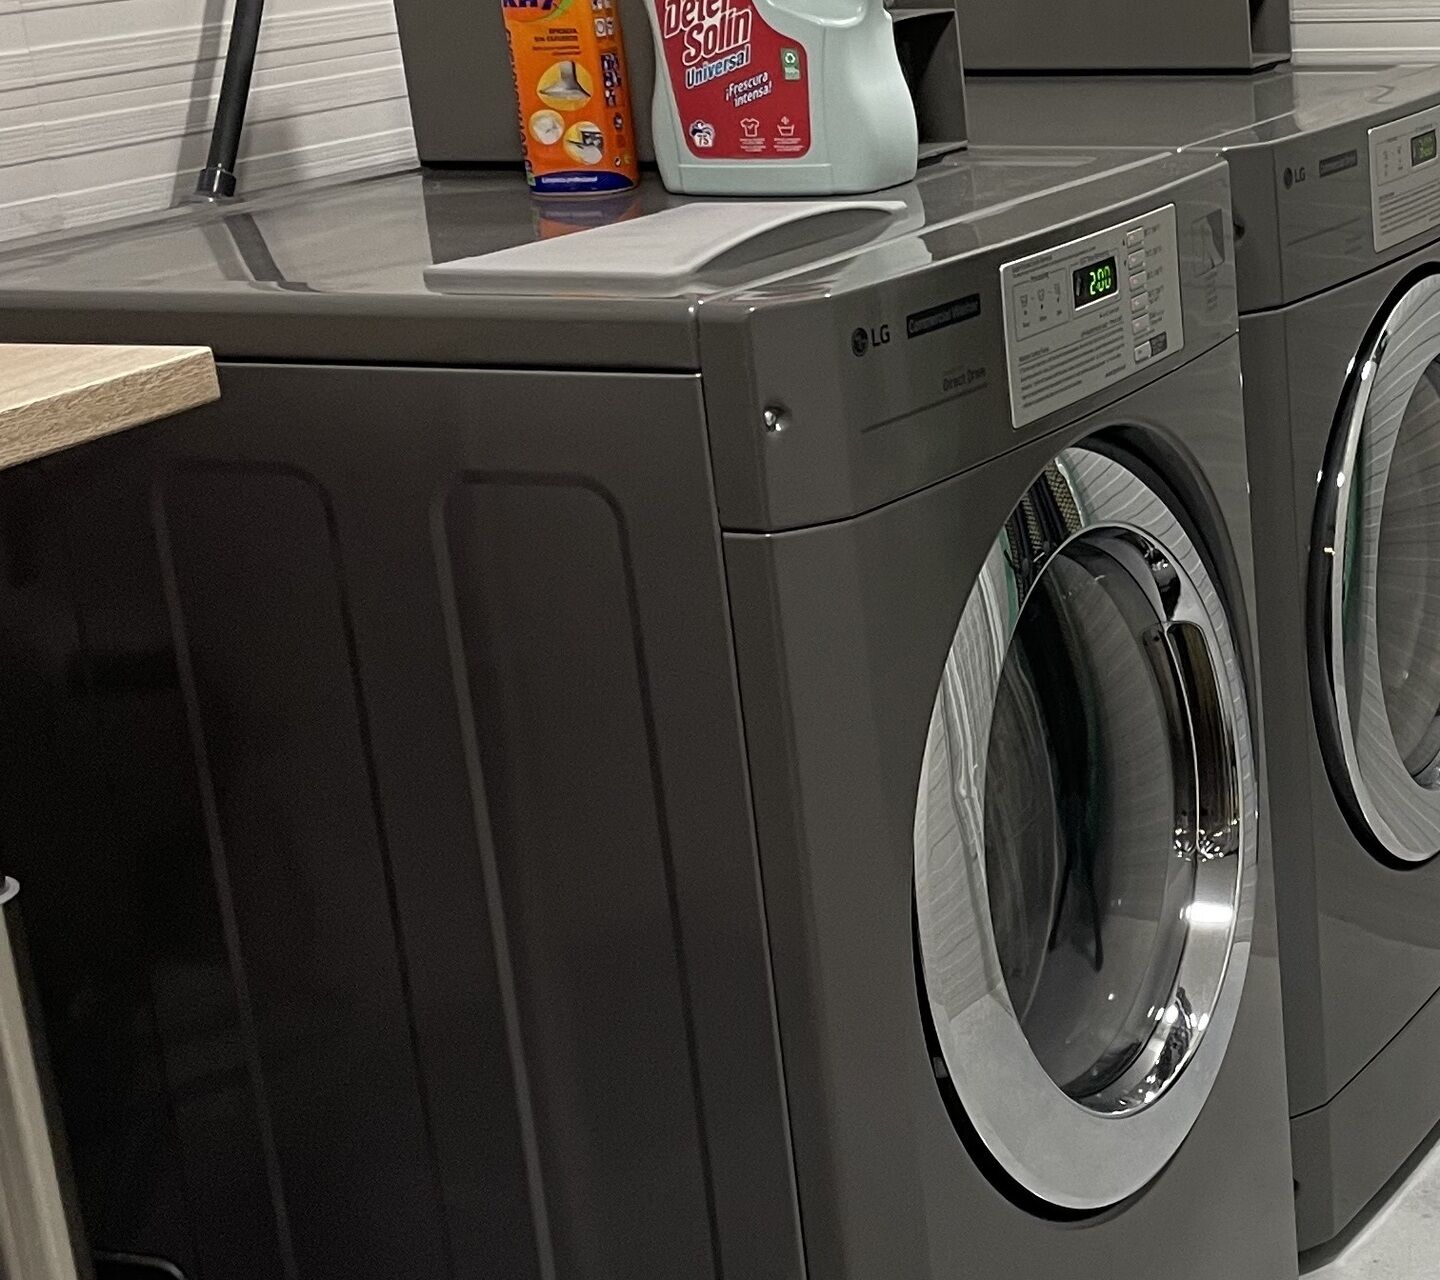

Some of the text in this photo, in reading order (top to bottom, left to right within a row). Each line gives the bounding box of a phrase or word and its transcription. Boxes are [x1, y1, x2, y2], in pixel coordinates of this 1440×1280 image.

[685, 44, 751, 89] Universal
[733, 80, 772, 108] intensa!
[1294, 166, 1305, 183] LG
[871, 324, 890, 347] LG
